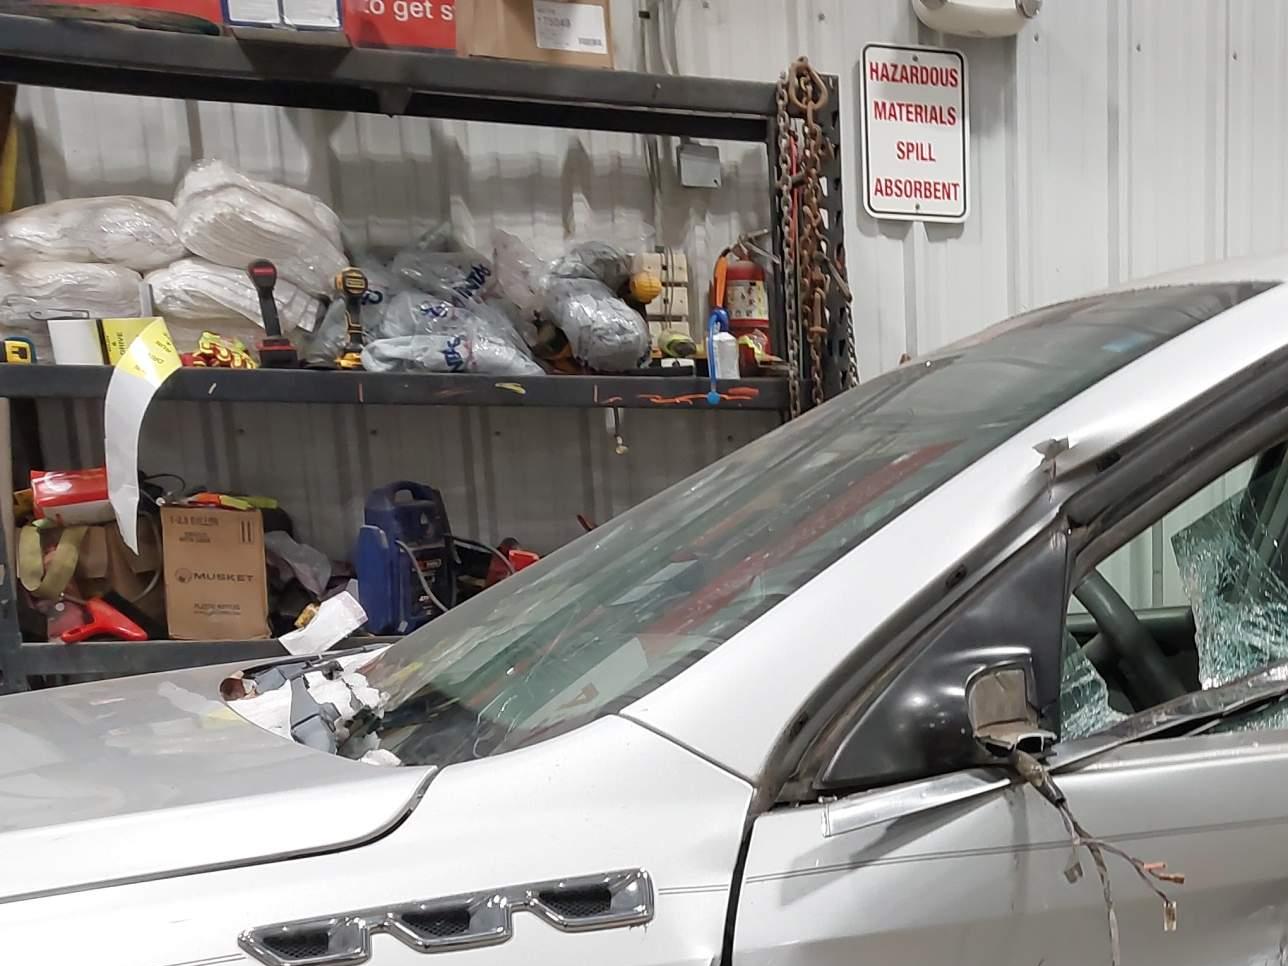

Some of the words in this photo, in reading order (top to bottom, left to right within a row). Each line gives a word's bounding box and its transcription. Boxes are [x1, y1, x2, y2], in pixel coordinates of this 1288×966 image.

[364, 0, 385, 15] o
[393, 0, 434, 21] get
[441, 4, 457, 20] s
[869, 61, 959, 87] HAZARDOUS
[873, 100, 957, 126] MATERIALS
[896, 140, 936, 162] SPILL
[874, 177, 960, 201] ABSORBENT
[193, 572, 255, 583] MUSKET
